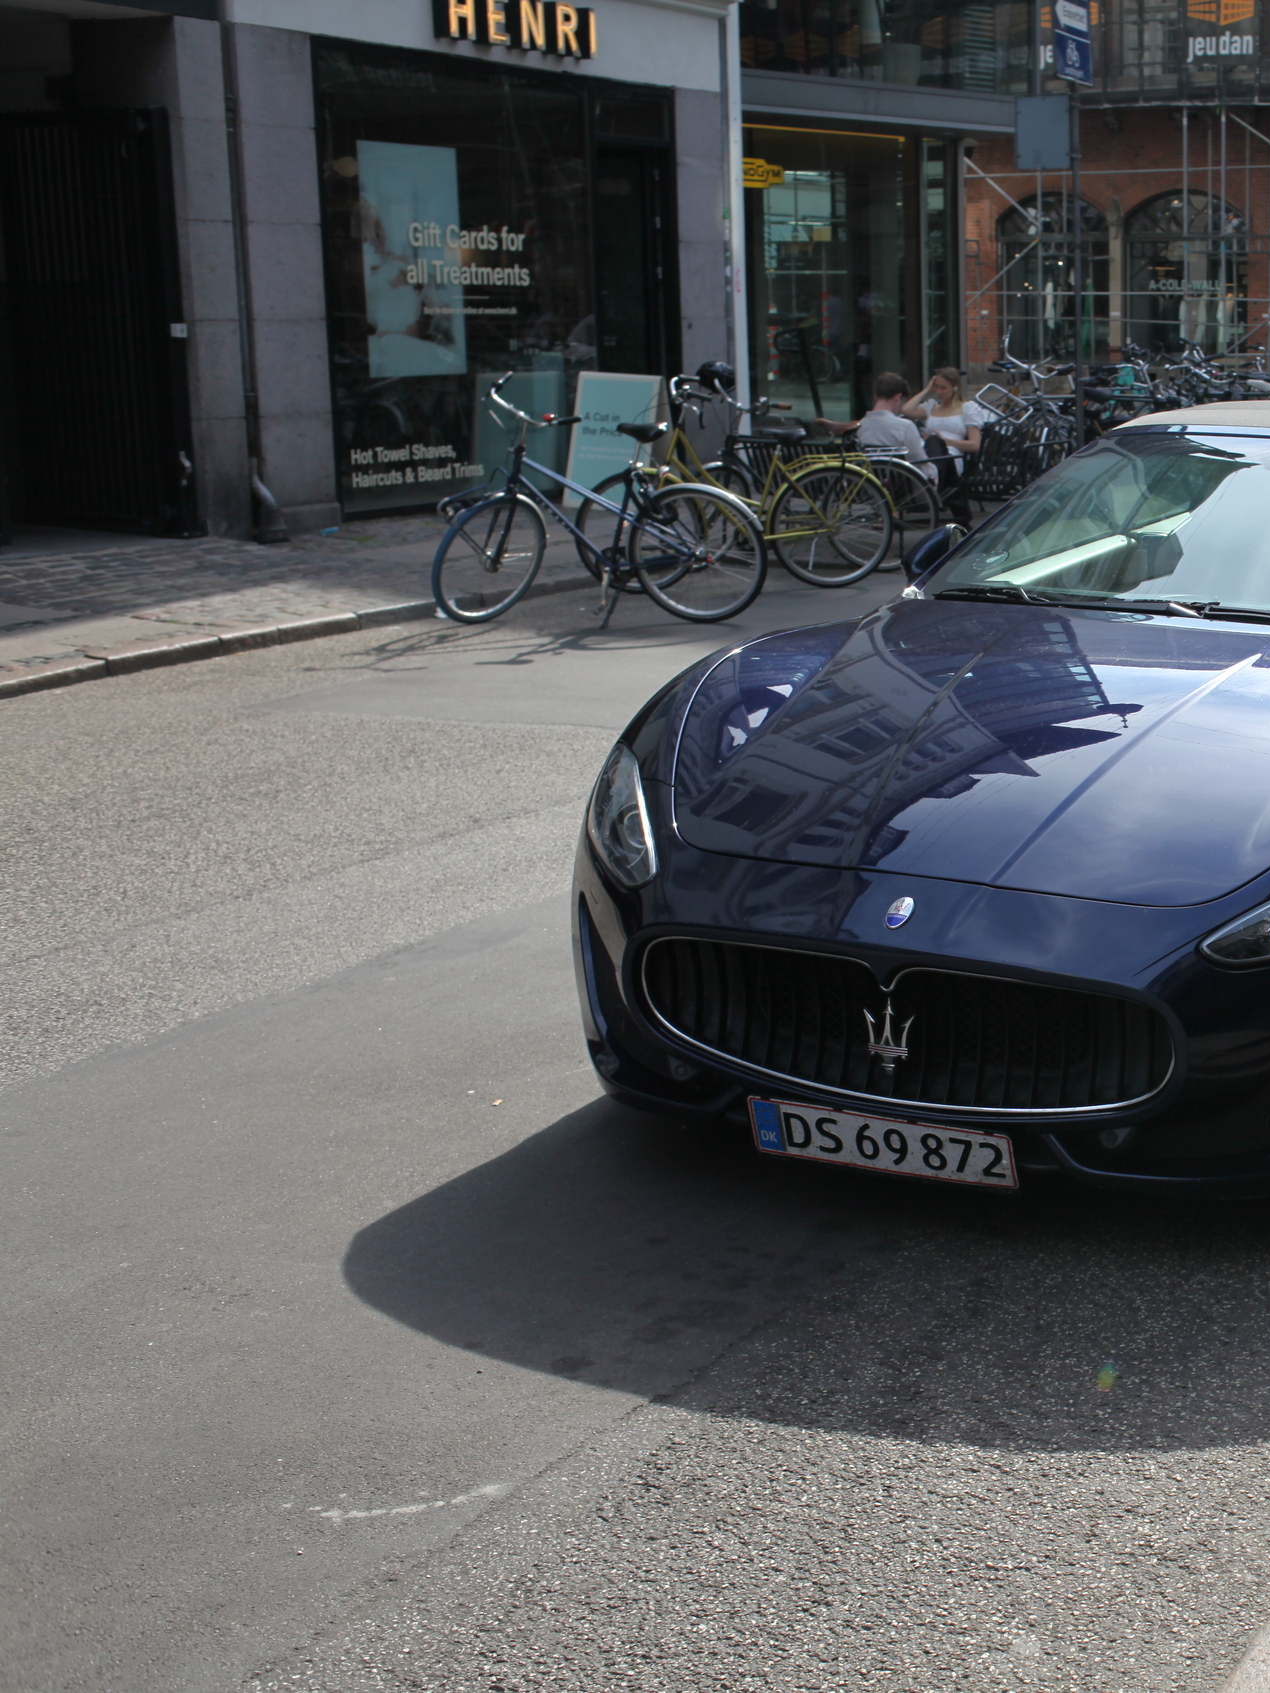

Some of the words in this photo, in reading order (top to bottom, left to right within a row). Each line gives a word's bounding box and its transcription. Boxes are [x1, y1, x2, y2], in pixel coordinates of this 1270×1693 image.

[448, 0, 597, 58] HENRI
[1039, 44, 1054, 70] je
[408, 222, 442, 247] Gift
[446, 225, 499, 251] Cards
[501, 226, 526, 252] for
[406, 258, 428, 284] all
[432, 260, 531, 286] Treatments
[350, 448, 374, 465] Hot
[375, 444, 410, 463] Towel
[412, 443, 457, 460] Shaves,
[352, 469, 403, 488] Haircuts
[405, 467, 415, 483] &
[417, 463, 452, 482] Beard
[453, 461, 485, 479] Trims
[760, 1129, 779, 1143] DK
[782, 1111, 843, 1154] DS
[855, 1122, 909, 1166] 69
[919, 1133, 1007, 1179] 872
